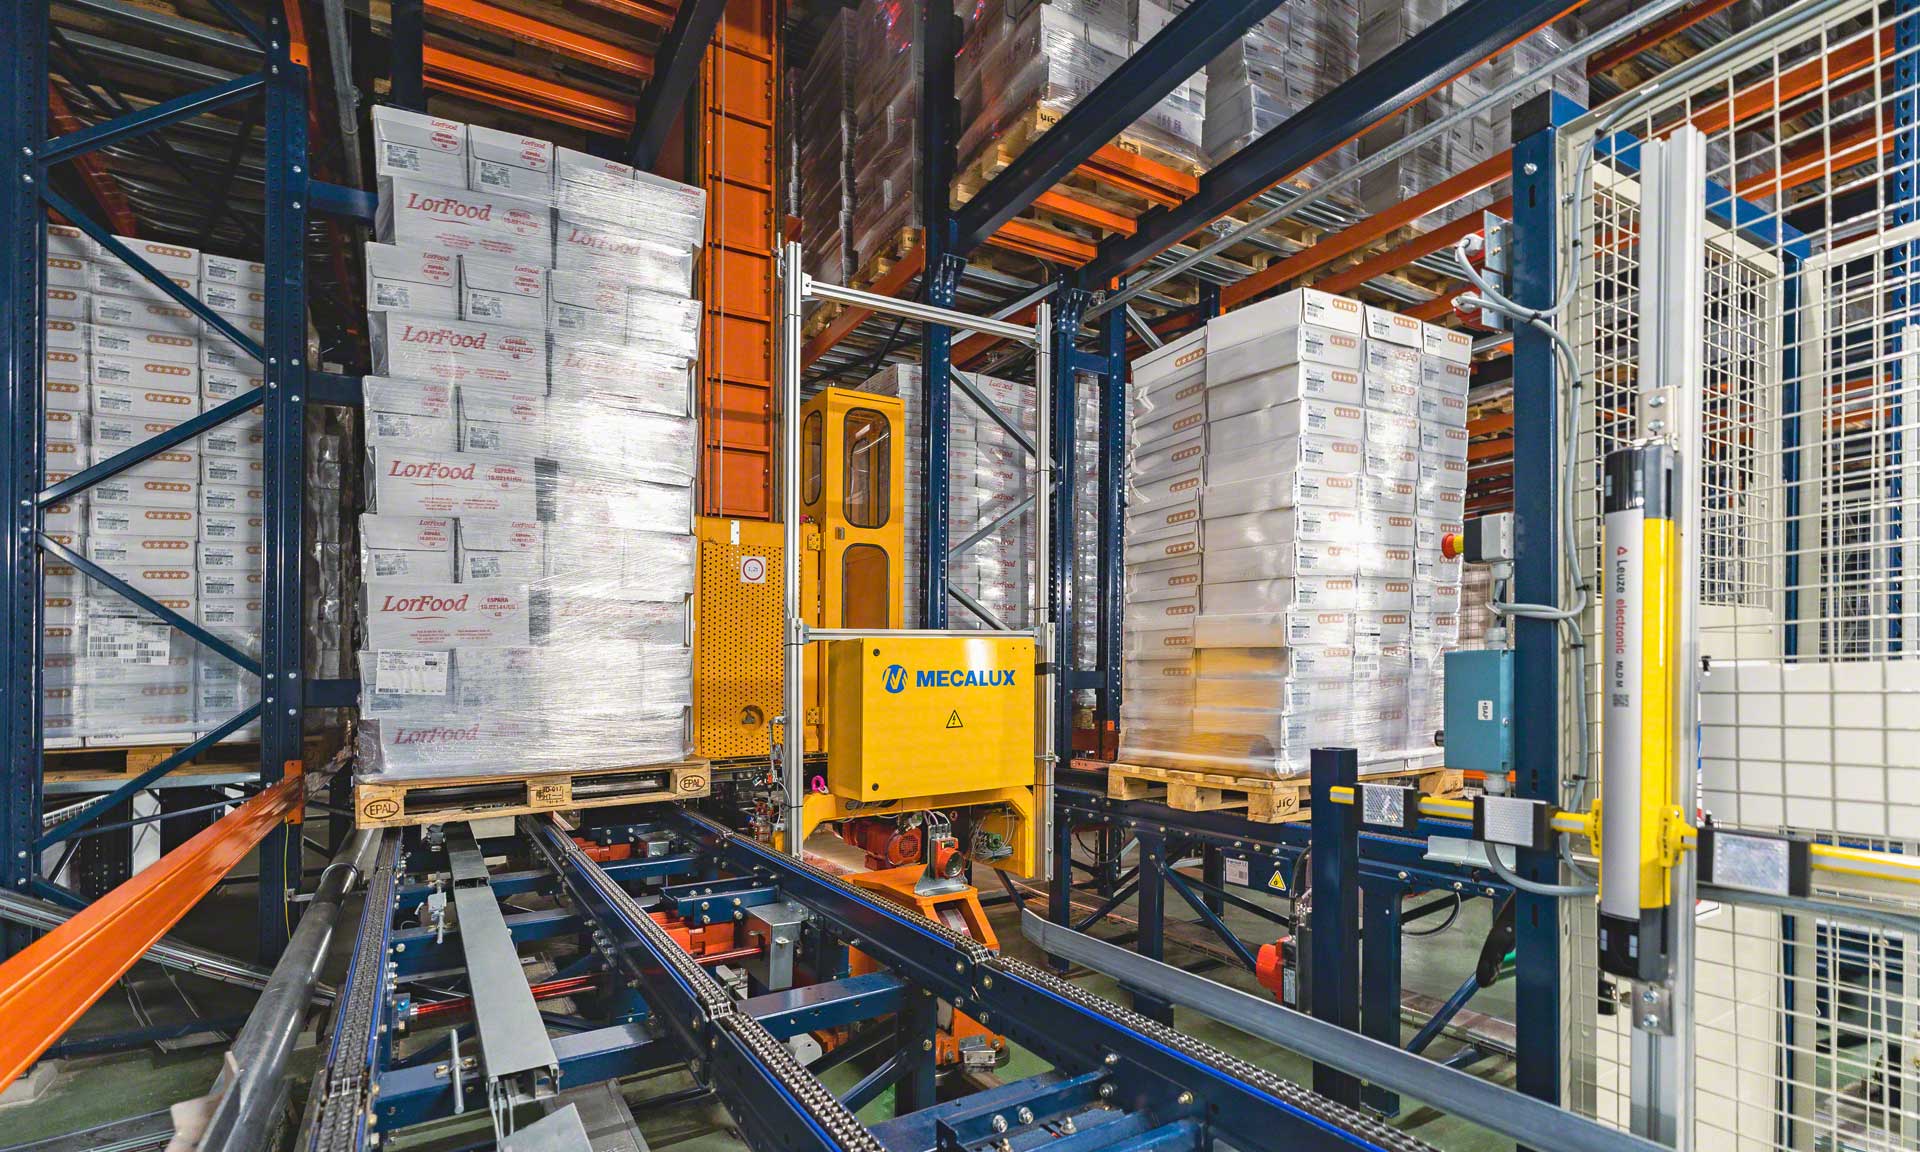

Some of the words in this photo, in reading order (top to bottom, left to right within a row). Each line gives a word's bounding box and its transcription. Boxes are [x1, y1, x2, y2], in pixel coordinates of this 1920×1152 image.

[407, 193, 493, 221] LorFood
[402, 325, 487, 350] LorFood
[388, 460, 476, 481] LorFood
[419, 519, 446, 527] LorFood
[1616, 559, 1628, 593] Leuze
[380, 594, 469, 612] LorFood
[1615, 598, 1628, 655] electronic
[916, 669, 1016, 687] MECALUX
[1616, 660, 1624, 679] MLD
[393, 723, 480, 745] LorFood
[683, 778, 702, 789] EPAL
[369, 802, 395, 815] EPAL
